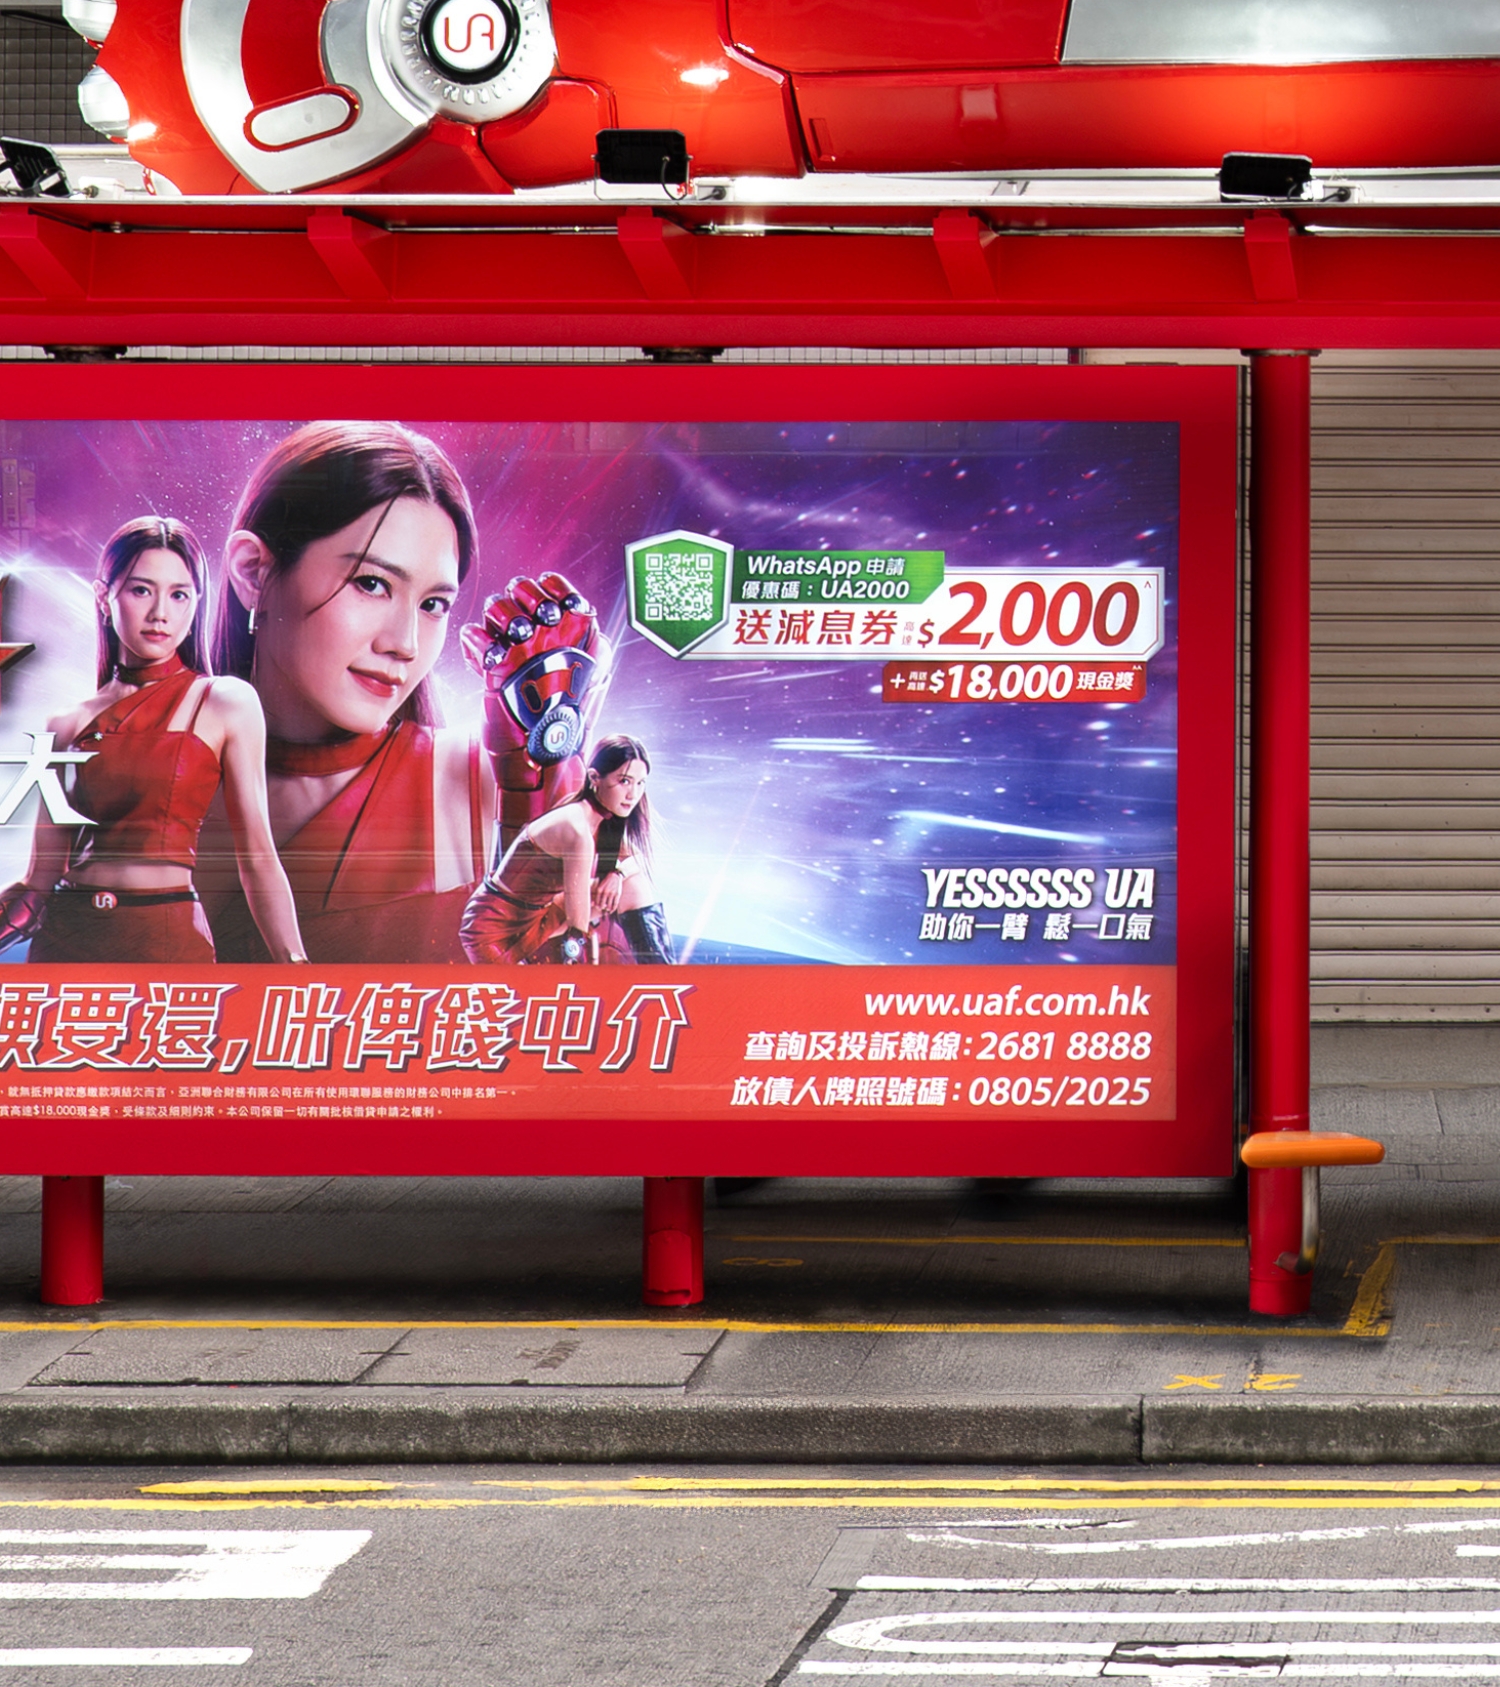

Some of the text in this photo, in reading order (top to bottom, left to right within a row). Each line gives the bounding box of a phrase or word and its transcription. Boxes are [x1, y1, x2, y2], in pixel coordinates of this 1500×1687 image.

[748, 555, 906, 580] WhatsApp 申請
[734, 608, 898, 645] 送減息券
[928, 664, 1074, 700] $18,000
[1104, 869, 1155, 909] UA
[920, 913, 1152, 942] 助你一臂 鬆一口氣
[864, 985, 1151, 1018] www.uaf.com.hk
[1067, 1030, 1152, 1061] 8888
